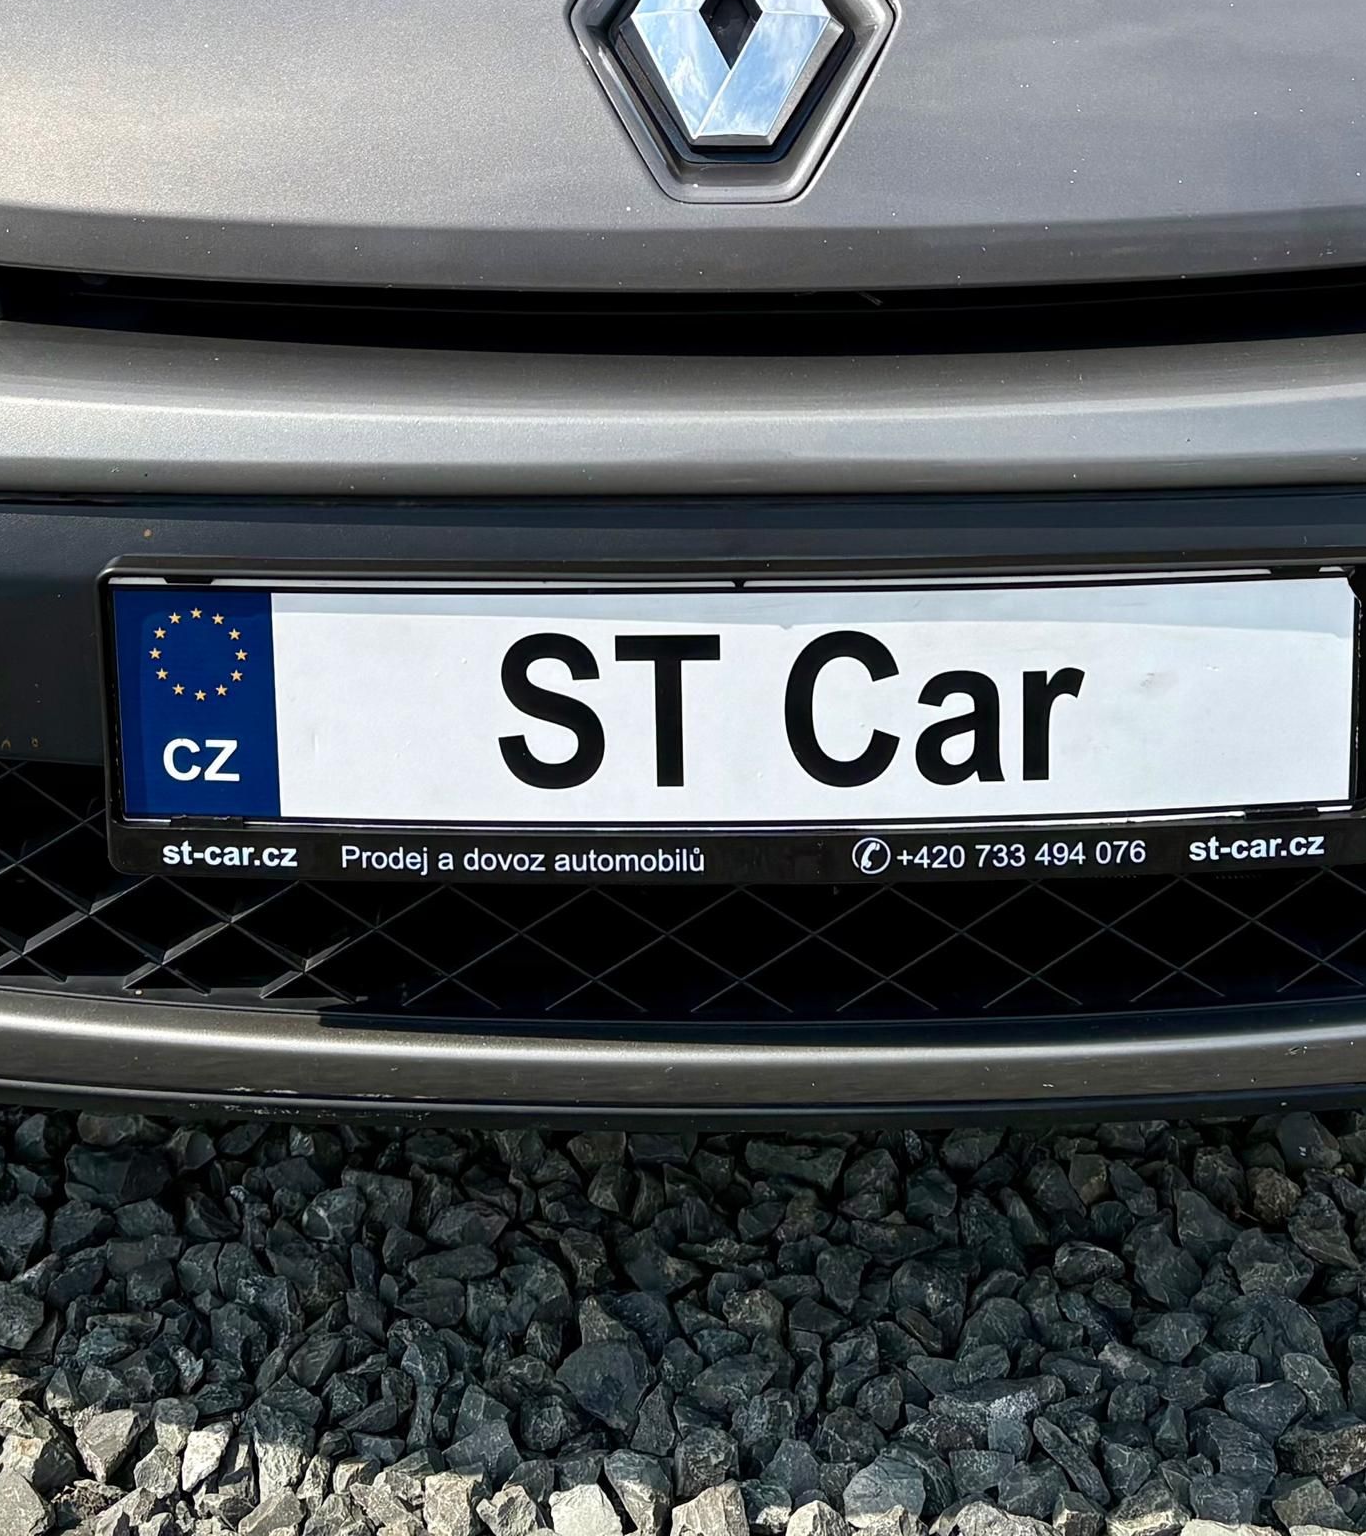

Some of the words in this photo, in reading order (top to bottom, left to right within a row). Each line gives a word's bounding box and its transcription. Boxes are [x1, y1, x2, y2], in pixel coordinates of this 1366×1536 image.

[498, 632, 720, 790] ST
[784, 629, 1085, 789] Car
[162, 738, 241, 783] CZ
[162, 840, 298, 868] st-car.cz
[341, 844, 428, 876] Prodej
[438, 852, 454, 871] a
[463, 847, 546, 872] dovoz
[554, 847, 705, 872] automobilů
[897, 845, 966, 869] +420
[975, 844, 1027, 867] 733
[1035, 842, 1086, 866] 494
[1095, 840, 1147, 864] 076
[1188, 836, 1325, 861] st-car.cz
